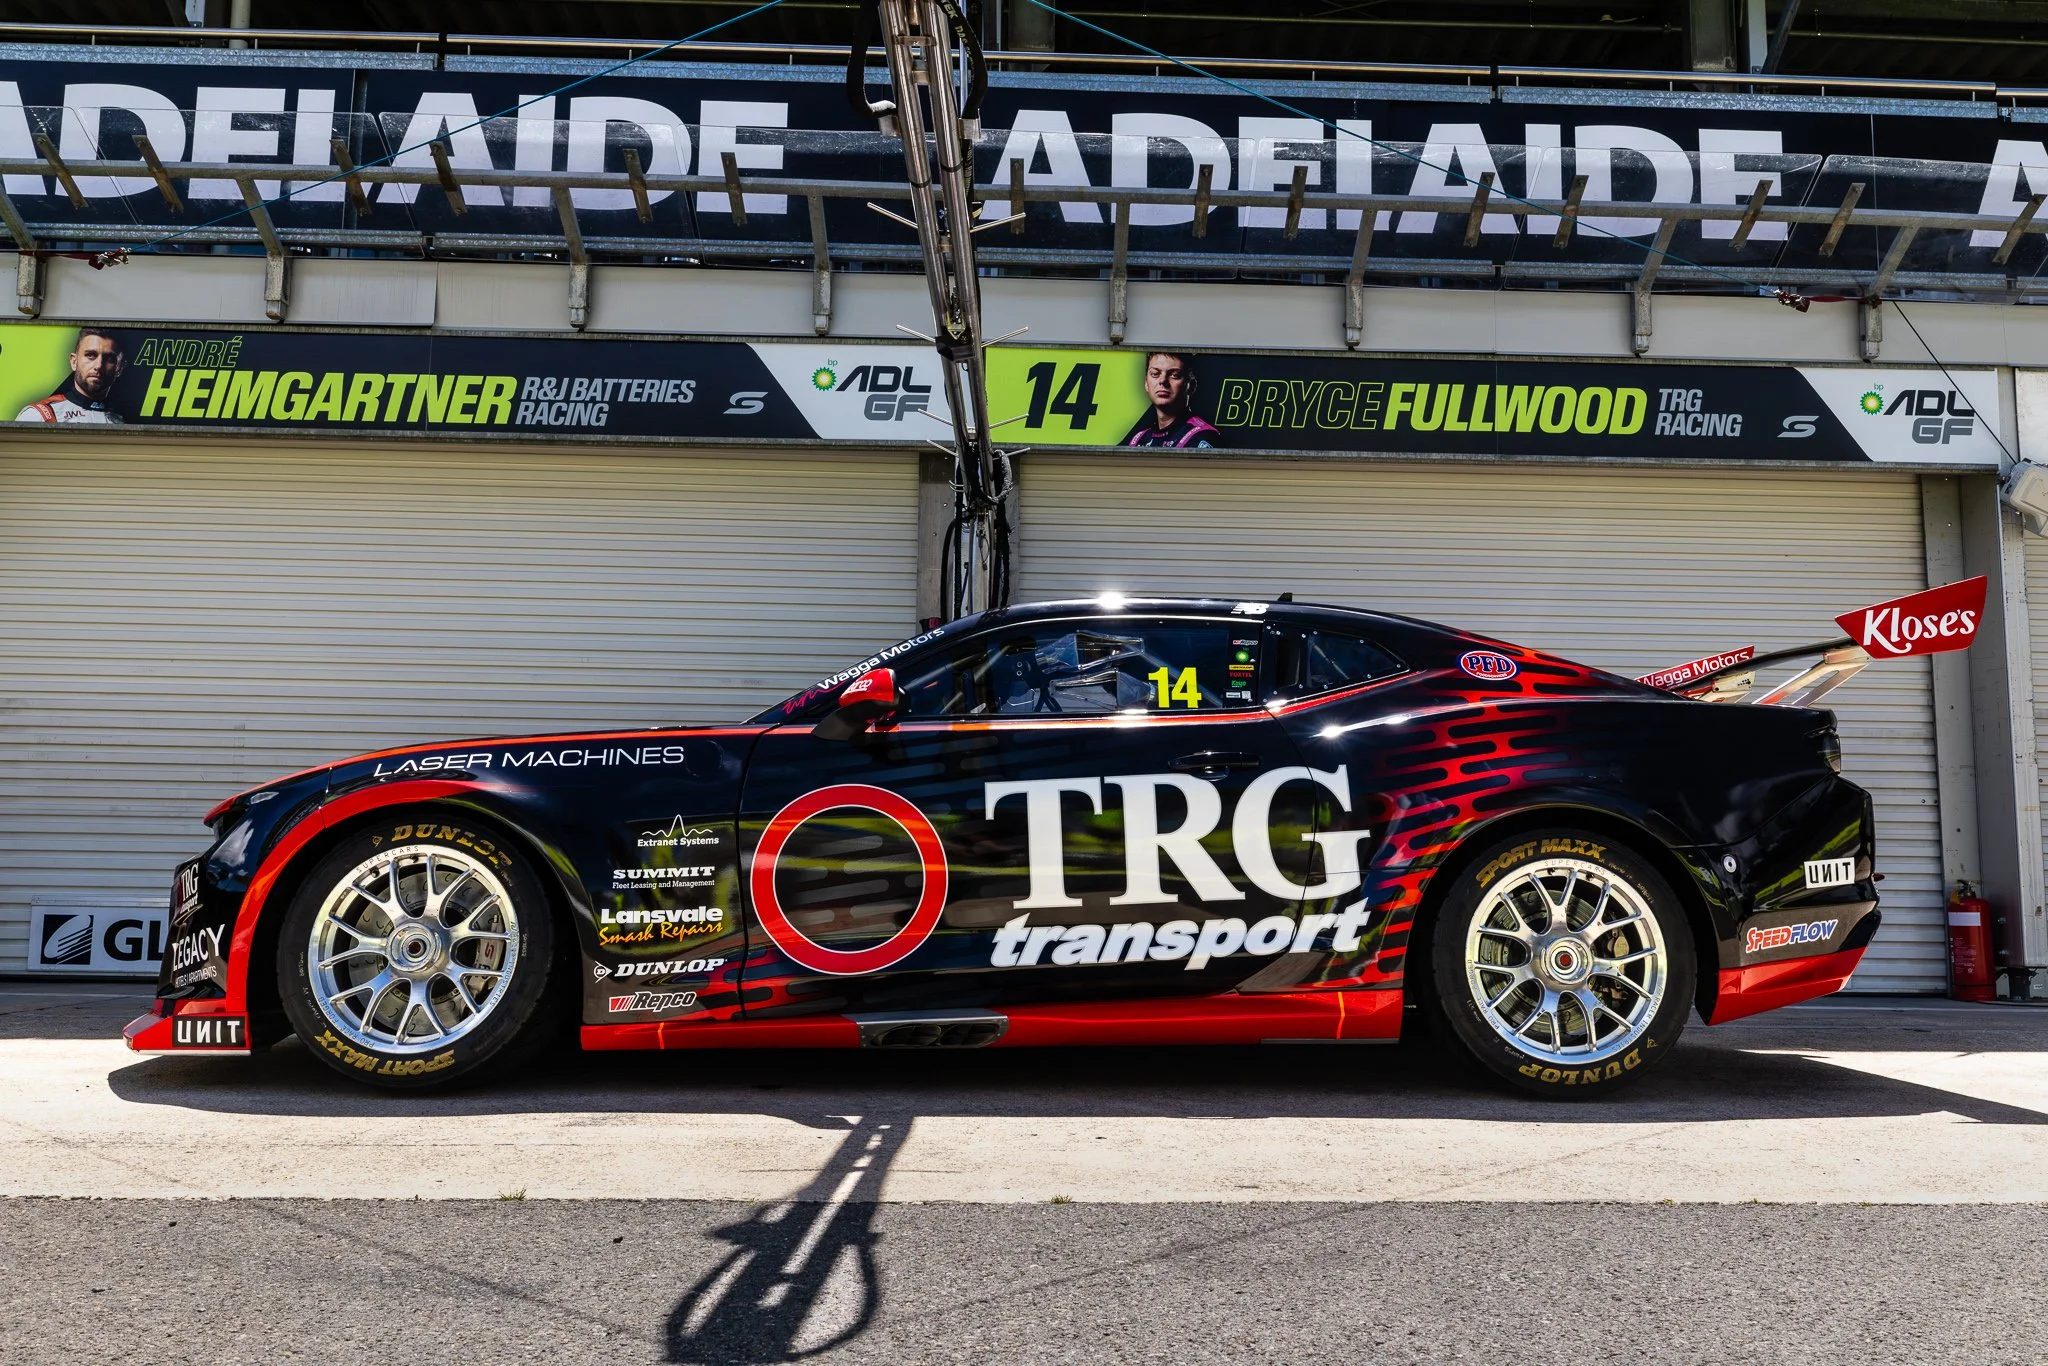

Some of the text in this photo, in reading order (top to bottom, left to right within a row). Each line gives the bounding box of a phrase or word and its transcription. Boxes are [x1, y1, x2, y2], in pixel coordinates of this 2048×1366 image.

[976, 110, 1788, 241] ADELAIDE
[134, 336, 243, 368] ANDRÉ
[827, 358, 838, 367] bp
[521, 376, 697, 403] R&J BATTERIES
[835, 365, 932, 394] ADL
[1873, 383, 1884, 392] bp
[140, 368, 518, 425] HEIMGARTNER
[863, 393, 930, 422] GF
[1025, 361, 1101, 431] 14
[1215, 378, 1648, 435] BRYCE FULLWOOD
[1658, 388, 1703, 412] TRG
[1883, 389, 1975, 418] ADL
[515, 402, 609, 427] RACING
[1654, 412, 1743, 437] RACING
[1911, 417, 1975, 445] GF
[1862, 606, 1976, 654] Klose's
[817, 655, 881, 690] Wagga
[880, 627, 945, 661] Motors
[1466, 654, 1513, 673] PFD
[1693, 650, 1750, 676] Motors
[1148, 666, 1202, 709] 14
[373, 746, 684, 777] LASER MACHINES
[637, 837, 719, 847] Extranet Systems
[984, 763, 1371, 909] TRG
[355, 845, 420, 873] SUPERCARS
[613, 866, 715, 880] SUMMIT
[1475, 838, 1607, 889] SPORT MAXX
[1544, 859, 1607, 876] SUPERCARS
[181, 862, 199, 902] TRG
[612, 879, 715, 890] Fleet Leasing and Management
[601, 905, 724, 924] Lansvale
[172, 923, 226, 971] LEGACY
[600, 921, 724, 946] Smash Repairs
[990, 897, 1371, 970] transport
[1746, 919, 1839, 953] SPEEDFLOW
[614, 958, 725, 977] DUNLOP
[630, 991, 696, 1012] Repco
[314, 1028, 455, 1076] SPORT MAXX
[1518, 1048, 1642, 1085] DUNLOP
